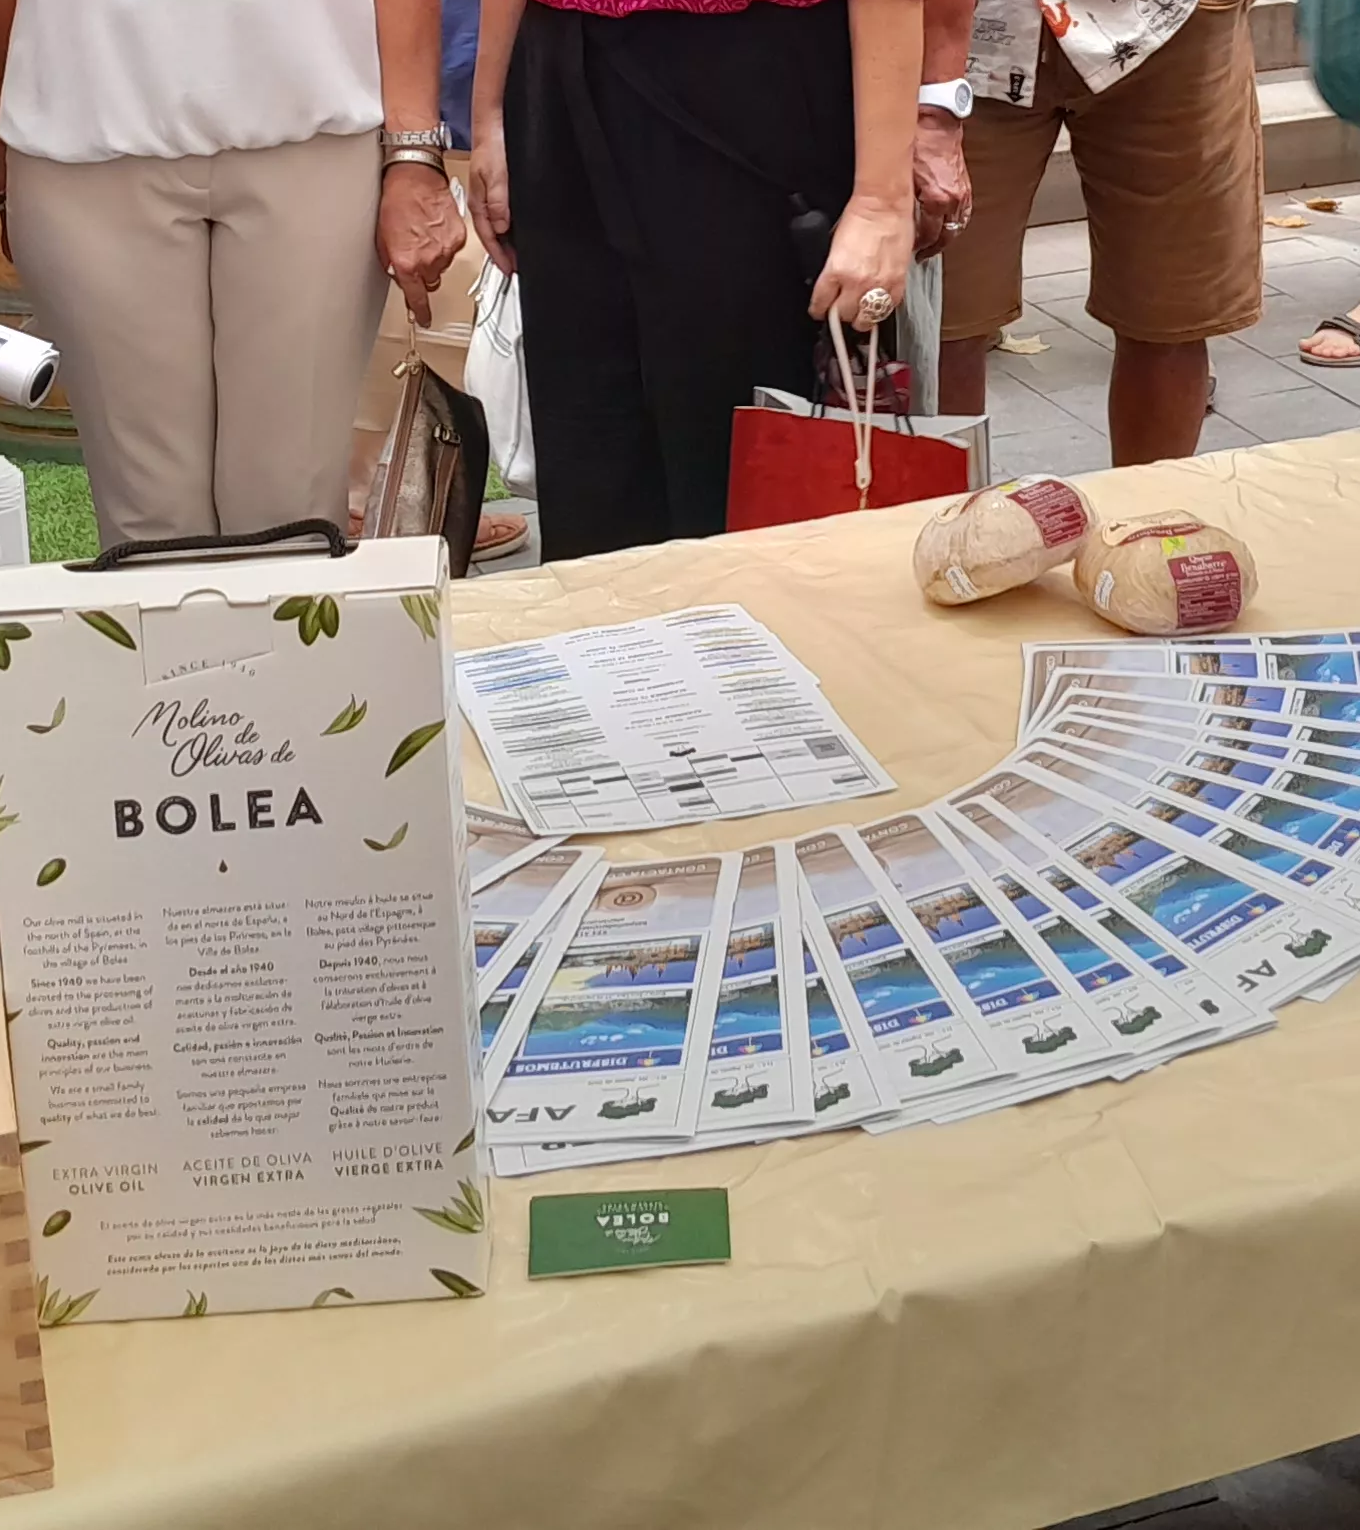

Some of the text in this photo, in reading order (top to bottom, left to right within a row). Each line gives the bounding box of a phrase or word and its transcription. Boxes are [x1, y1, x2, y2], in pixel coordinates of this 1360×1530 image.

[131, 698, 245, 747] Molino
[234, 721, 260, 745] de
[171, 732, 296, 778] Olivas de
[113, 786, 324, 839] BOLEA
[250, 961, 274, 973] 1940
[332, 1142, 443, 1162] HUILE D'OLIVE
[183, 1152, 313, 1172] ACEITE DE OLIVA
[334, 1159, 444, 1177] VIERGE EXTRA
[52, 1163, 159, 1181] EXTRA VIRGIN
[193, 1169, 305, 1187] VIRGEN EXTRA
[69, 1180, 144, 1196] OLIVE OIL
[596, 1212, 669, 1227] BOLEA
